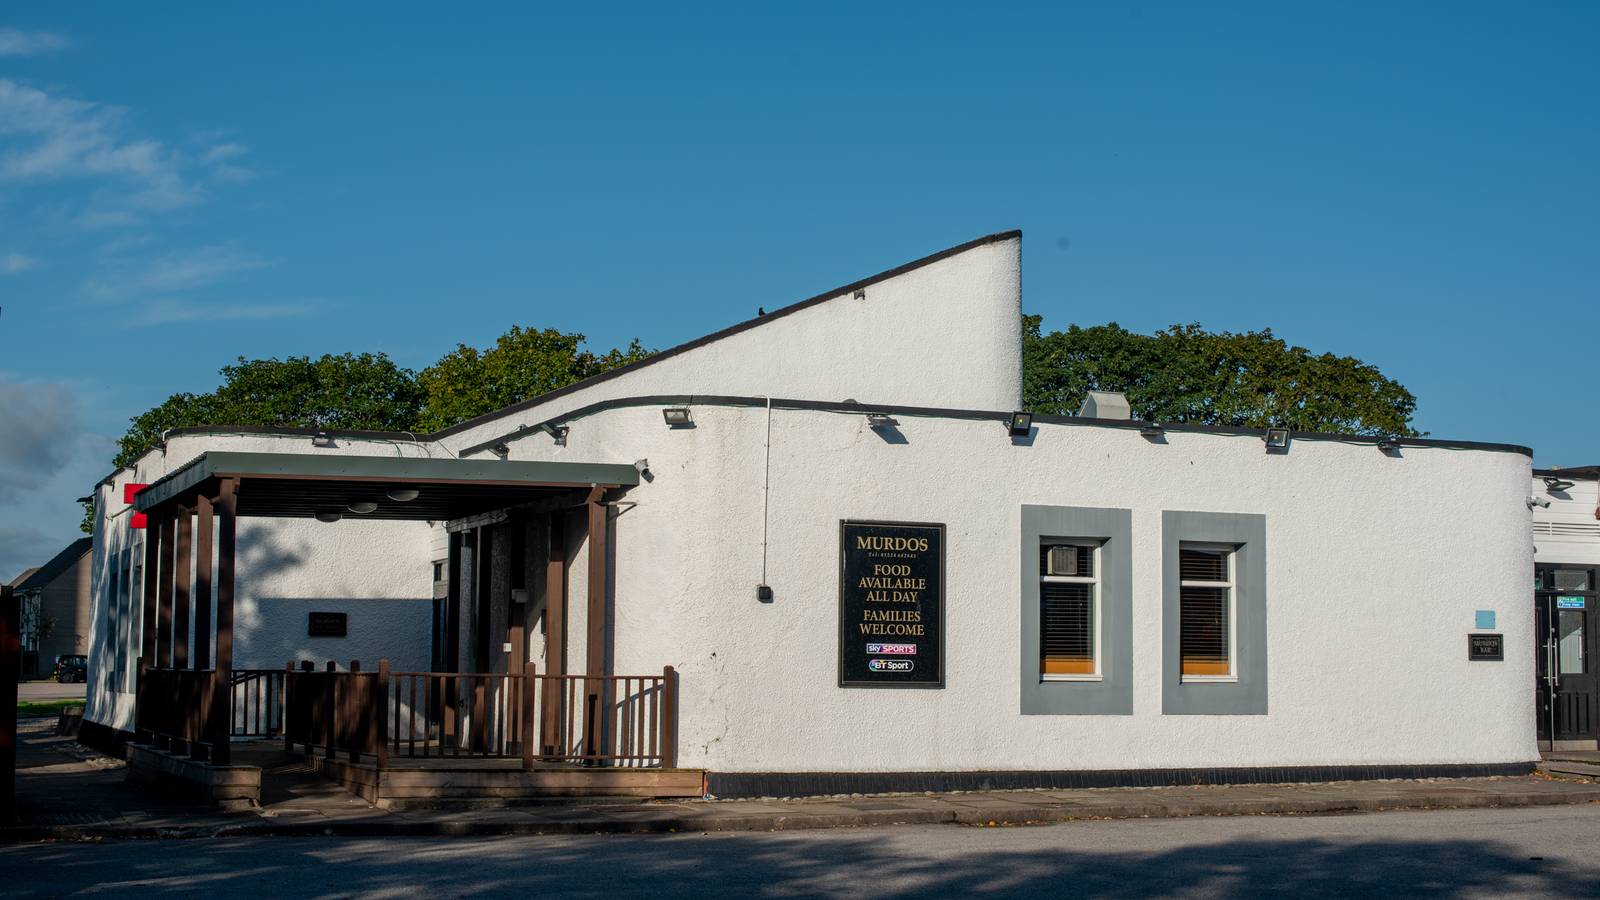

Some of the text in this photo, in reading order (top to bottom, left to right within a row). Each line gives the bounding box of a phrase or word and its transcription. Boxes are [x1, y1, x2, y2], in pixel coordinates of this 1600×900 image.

[874, 564, 912, 576] FOOD
[858, 576, 927, 590] AVAILABLE
[866, 590, 918, 603] ALL DAY
[863, 609, 921, 623] FAMILIES
[858, 623, 925, 636] WELCOME
[868, 644, 915, 653] sky SPORTS
[887, 661, 909, 670] Sport
